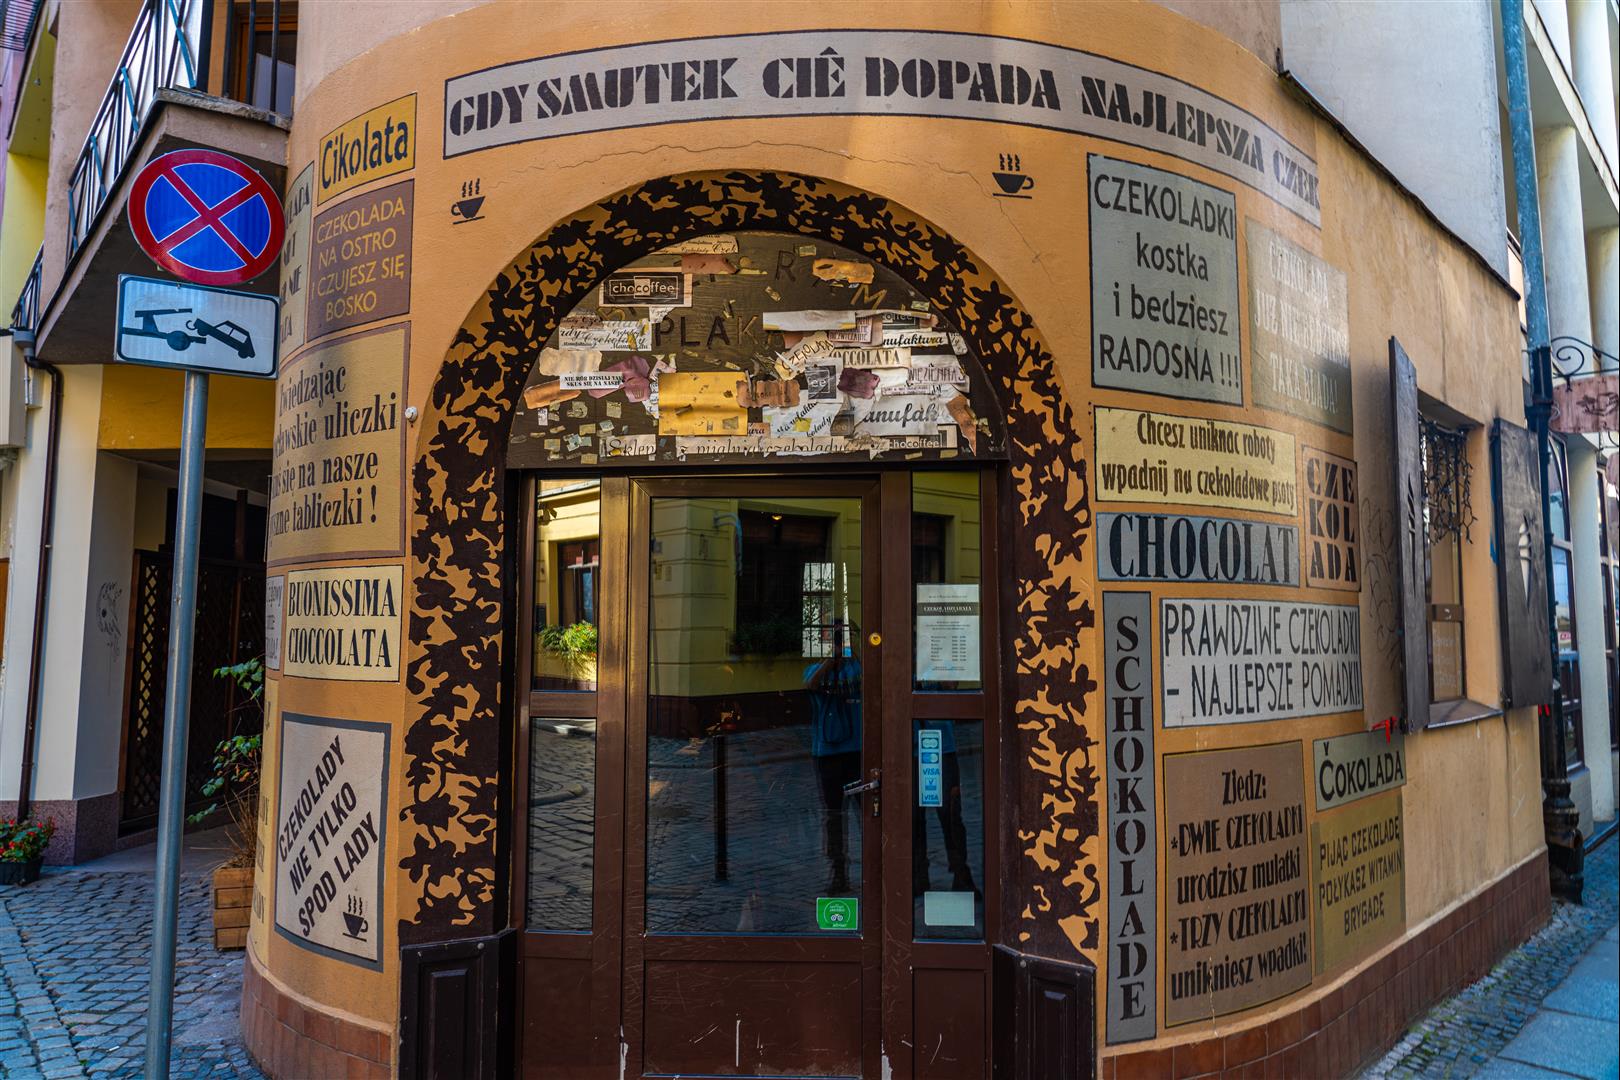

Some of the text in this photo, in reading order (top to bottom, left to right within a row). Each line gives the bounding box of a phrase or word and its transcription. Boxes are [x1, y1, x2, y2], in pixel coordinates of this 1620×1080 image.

[449, 84, 530, 136] GDY
[536, 57, 740, 119] SMUTEK
[762, 46, 846, 98] CIÊ
[864, 56, 1062, 111] DOPADA
[1081, 75, 1266, 173] NAJLEPSZA
[321, 116, 409, 189] Cikolata
[316, 197, 406, 244] CZEKOLADA
[1094, 174, 1234, 240] CZEKOLADKI
[318, 248, 337, 270] NA
[341, 227, 397, 261] OSTRO
[1136, 232, 1208, 281] kostka
[317, 262, 377, 297] CZUJESZ
[381, 254, 406, 281] SIĘ
[612, 281, 675, 294] chocoffee
[325, 291, 377, 323] BOSKO
[1113, 282, 1228, 336] i bedziesz
[1100, 334, 1214, 384] RADOSNA
[1270, 352, 1302, 401] TAKA
[279, 361, 346, 417] Zwiedzając
[324, 392, 396, 440] uliczki
[1136, 413, 1275, 464] Chcesz uniknac roboty
[298, 460, 315, 489] na
[322, 451, 378, 485] nasze
[1101, 458, 1168, 496] wpadnij
[1196, 465, 1270, 501] czekoladowe
[1272, 478, 1295, 511] psoty
[1307, 457, 1355, 504] CZE
[292, 486, 363, 532] tabliczki
[370, 484, 377, 524] !
[1309, 497, 1355, 543] KOL
[1108, 513, 1294, 584] CHOCOLAT
[1310, 541, 1358, 583] ADA
[288, 578, 397, 617] BUONISSIMA
[288, 627, 393, 668] CIOCCOLATA
[1164, 603, 1360, 657] PRAWDZIWE CZEKOLADKI
[1191, 662, 1294, 718] NAJLEPSZE
[923, 768, 940, 776] VISA
[1221, 769, 1267, 805] Zjedz:
[1318, 740, 1405, 802] ČOKOLADA
[278, 734, 346, 863] CZEKOLADY
[1111, 615, 1148, 1022] SCHOKOLADE
[289, 781, 357, 896] NIE TYLKO
[1225, 803, 1303, 850] CZEKOLADKI
[1319, 815, 1400, 870] PIJĄC CZEKOLADĘ
[298, 810, 380, 938] SPOD LADY
[1176, 847, 1301, 905] urodzisz mulatki
[1318, 851, 1402, 909] POŁYKASZ WITAMIN
[1228, 889, 1306, 941] CZEKOLADKI
[1344, 892, 1386, 937] BRYGADĘ
[1171, 931, 1308, 1001] unikniesz wpadki!
